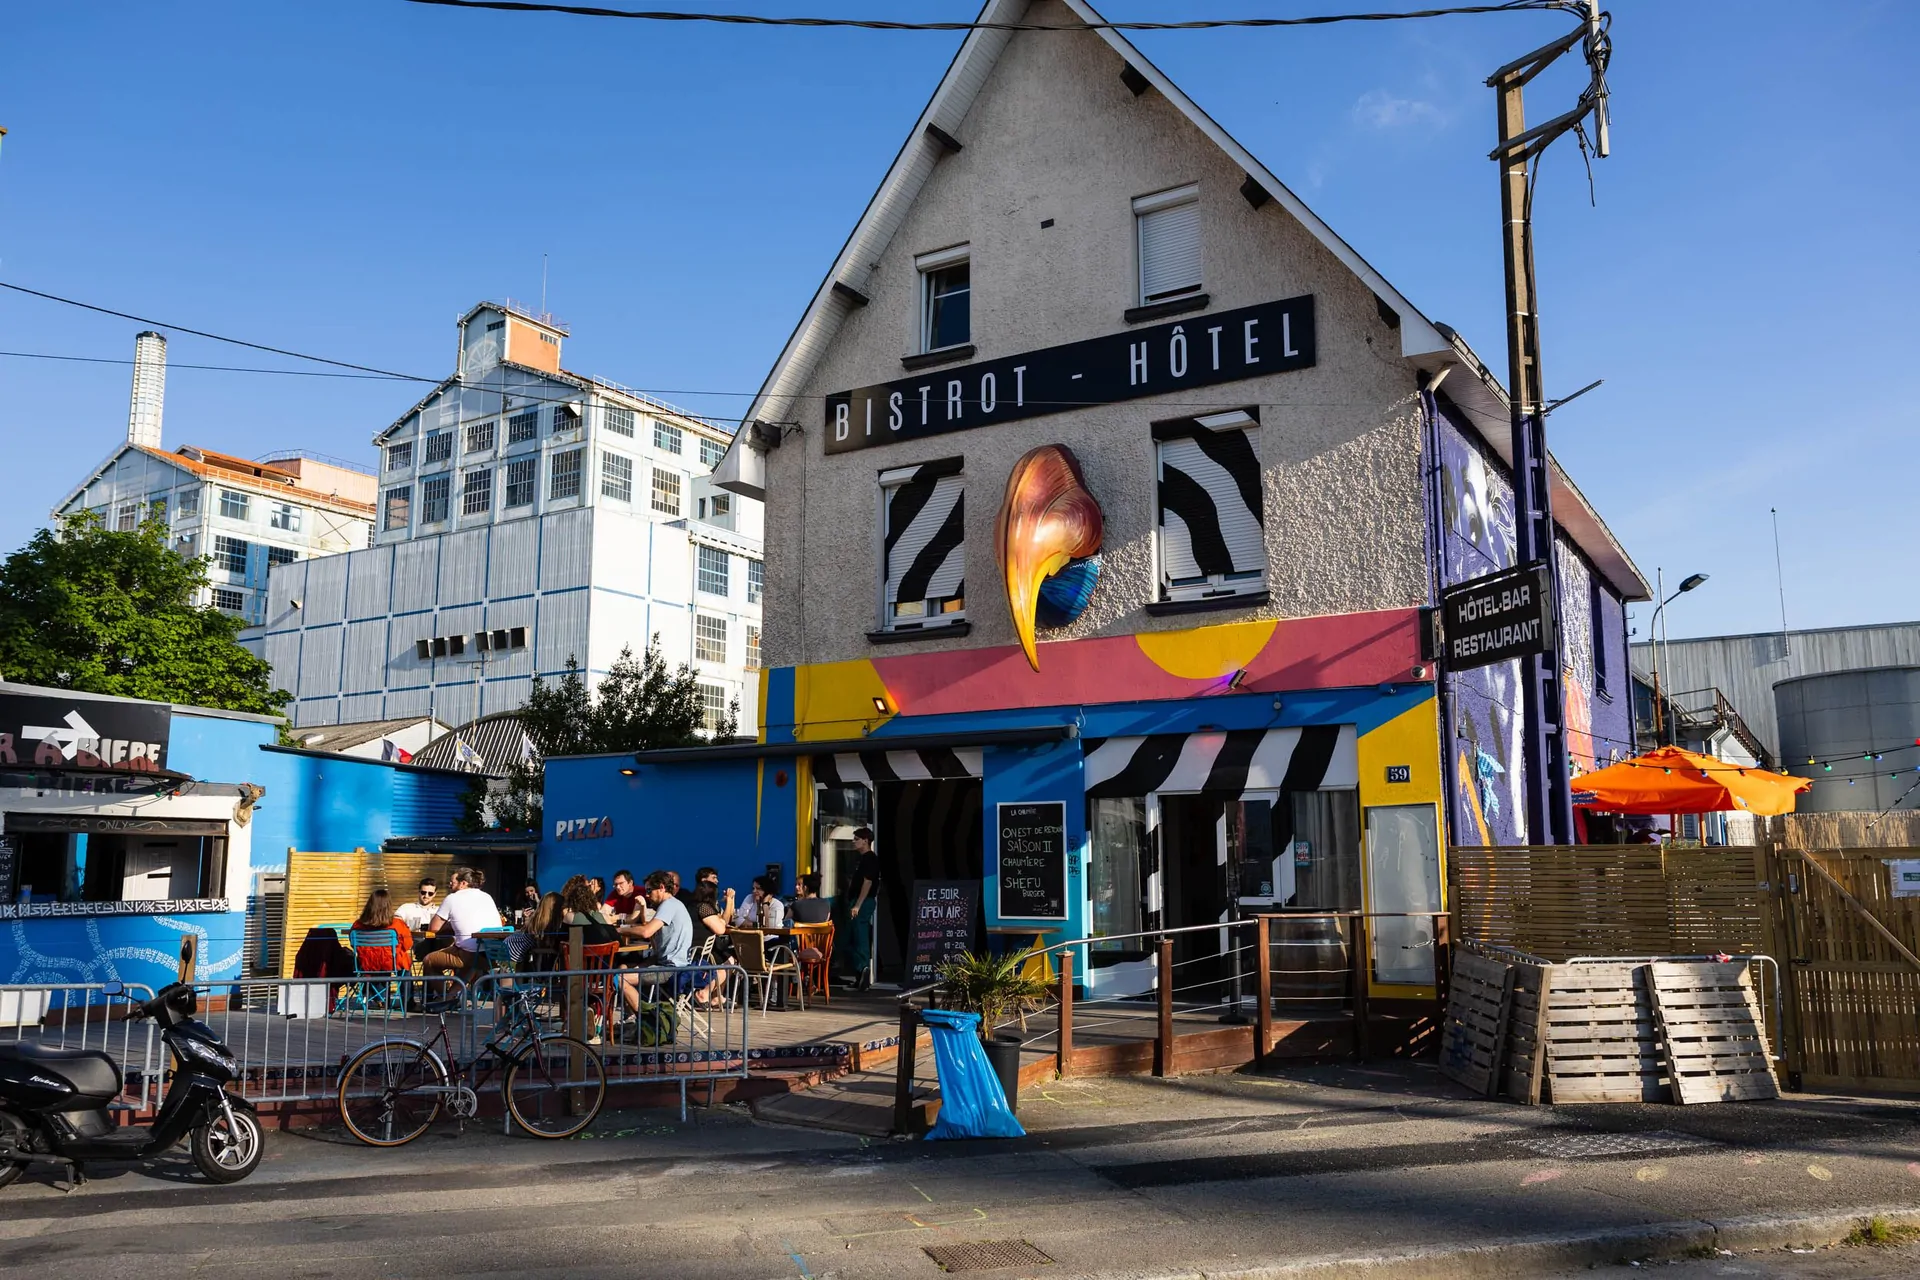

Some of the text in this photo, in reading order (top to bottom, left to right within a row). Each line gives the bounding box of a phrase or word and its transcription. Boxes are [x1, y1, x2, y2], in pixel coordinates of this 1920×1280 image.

[835, 366, 1028, 441] BISTROT
[1129, 313, 1299, 387] HÔTEL
[1454, 618, 1540, 658] RESTAURANT
[77, 737, 162, 772] BIERE
[1390, 767, 1408, 780] 59
[97, 819, 130, 831] ONLY
[556, 816, 613, 841] PIZZA
[1034, 826, 1042, 834] DE
[1004, 877, 1041, 888] SHEFU
[927, 888, 960, 900] CE SOIR
[1022, 889, 1046, 898] BURGER
[921, 906, 960, 919] OPEN AIR
[912, 964, 933, 973] AFTER
